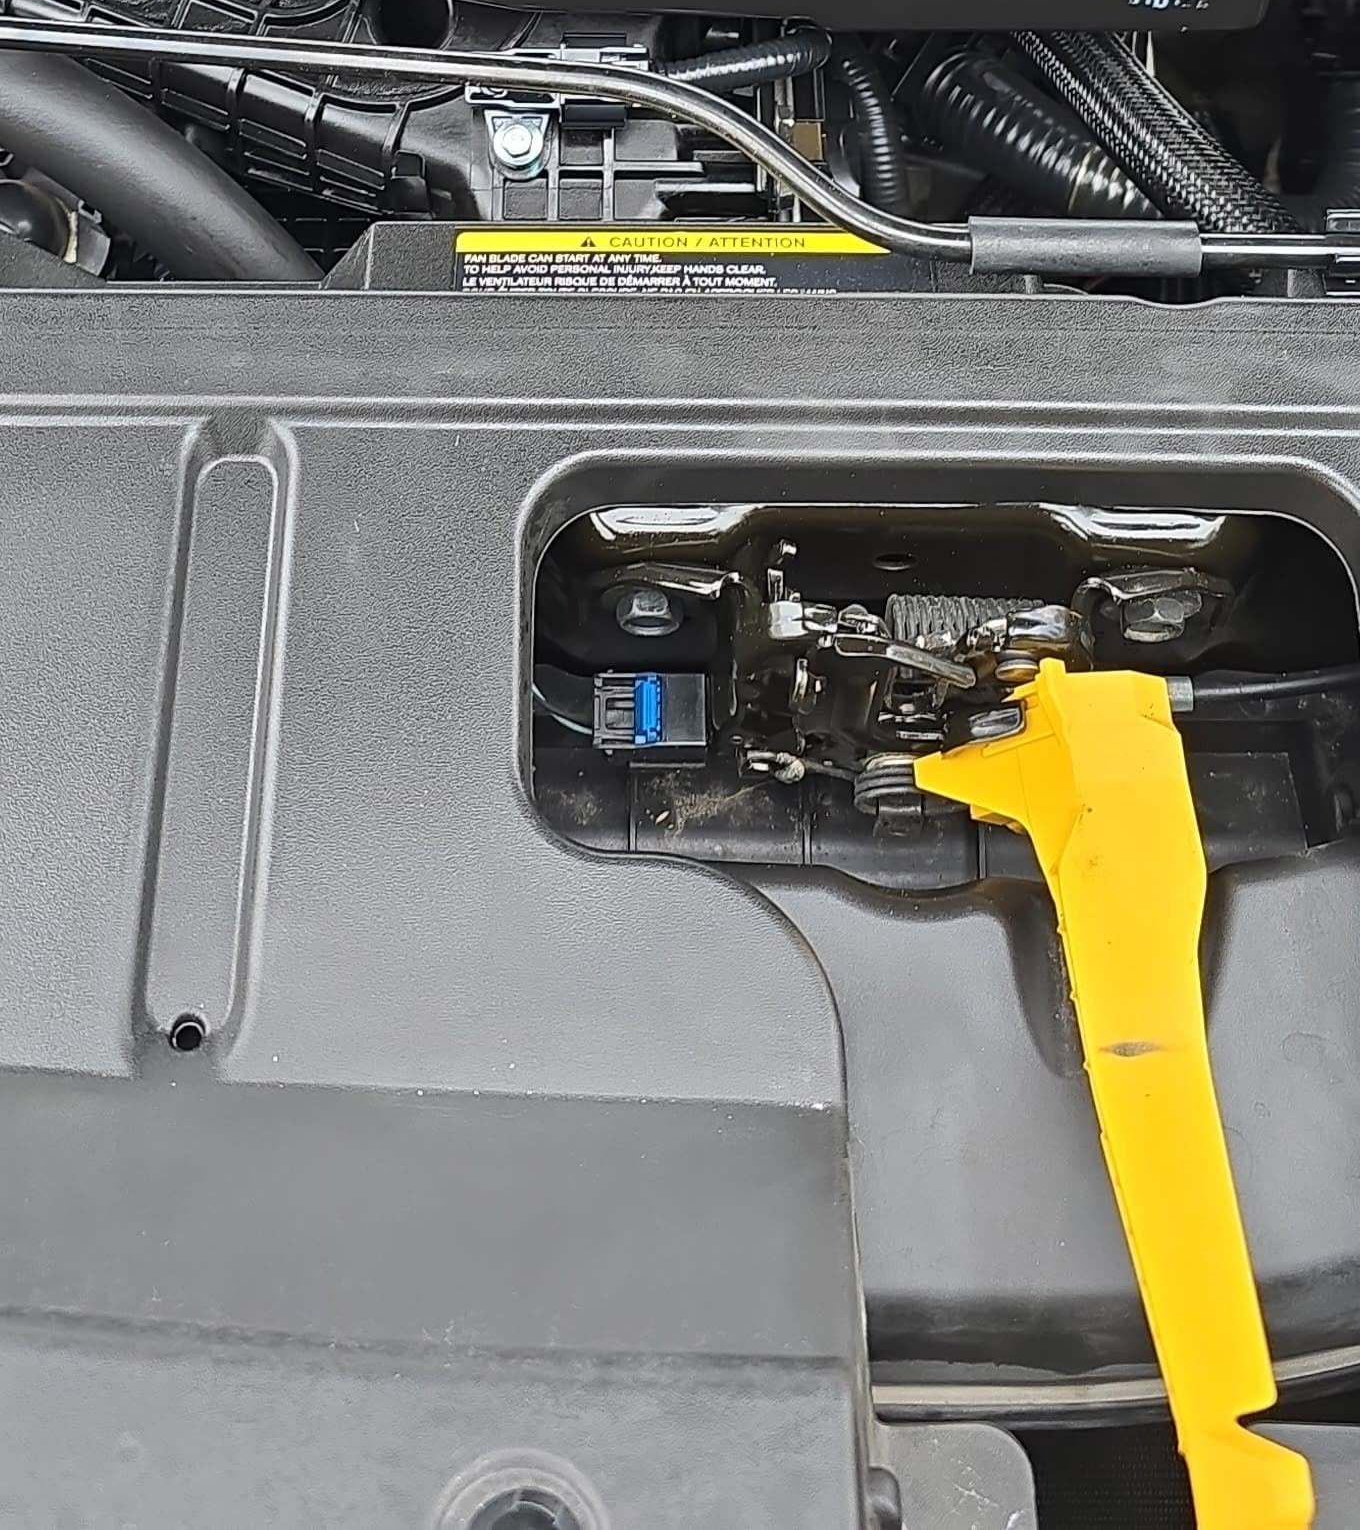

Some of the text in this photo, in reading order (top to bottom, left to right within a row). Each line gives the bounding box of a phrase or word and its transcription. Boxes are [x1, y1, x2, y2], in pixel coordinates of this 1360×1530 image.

[609, 236, 806, 248] CAUTION / ATTENTION
[464, 254, 663, 264] FAN BLADE CAN START AT ANY TIME.
[464, 265, 480, 274] TO
[482, 265, 512, 274] HELP
[513, 265, 549, 274] AVOID
[550, 265, 612, 274] PERSONAL
[684, 265, 725, 274] HANDS
[726, 265, 767, 274] CLEAR.
[463, 277, 477, 287] LE
[478, 277, 553, 287] VENTILATEUR
[554, 277, 598, 287] RISQUE
[599, 277, 616, 287] DE
[617, 274, 681, 287] DÉMARRER
[692, 277, 724, 287] TOUT
[725, 277, 778, 287] MOMENT.
